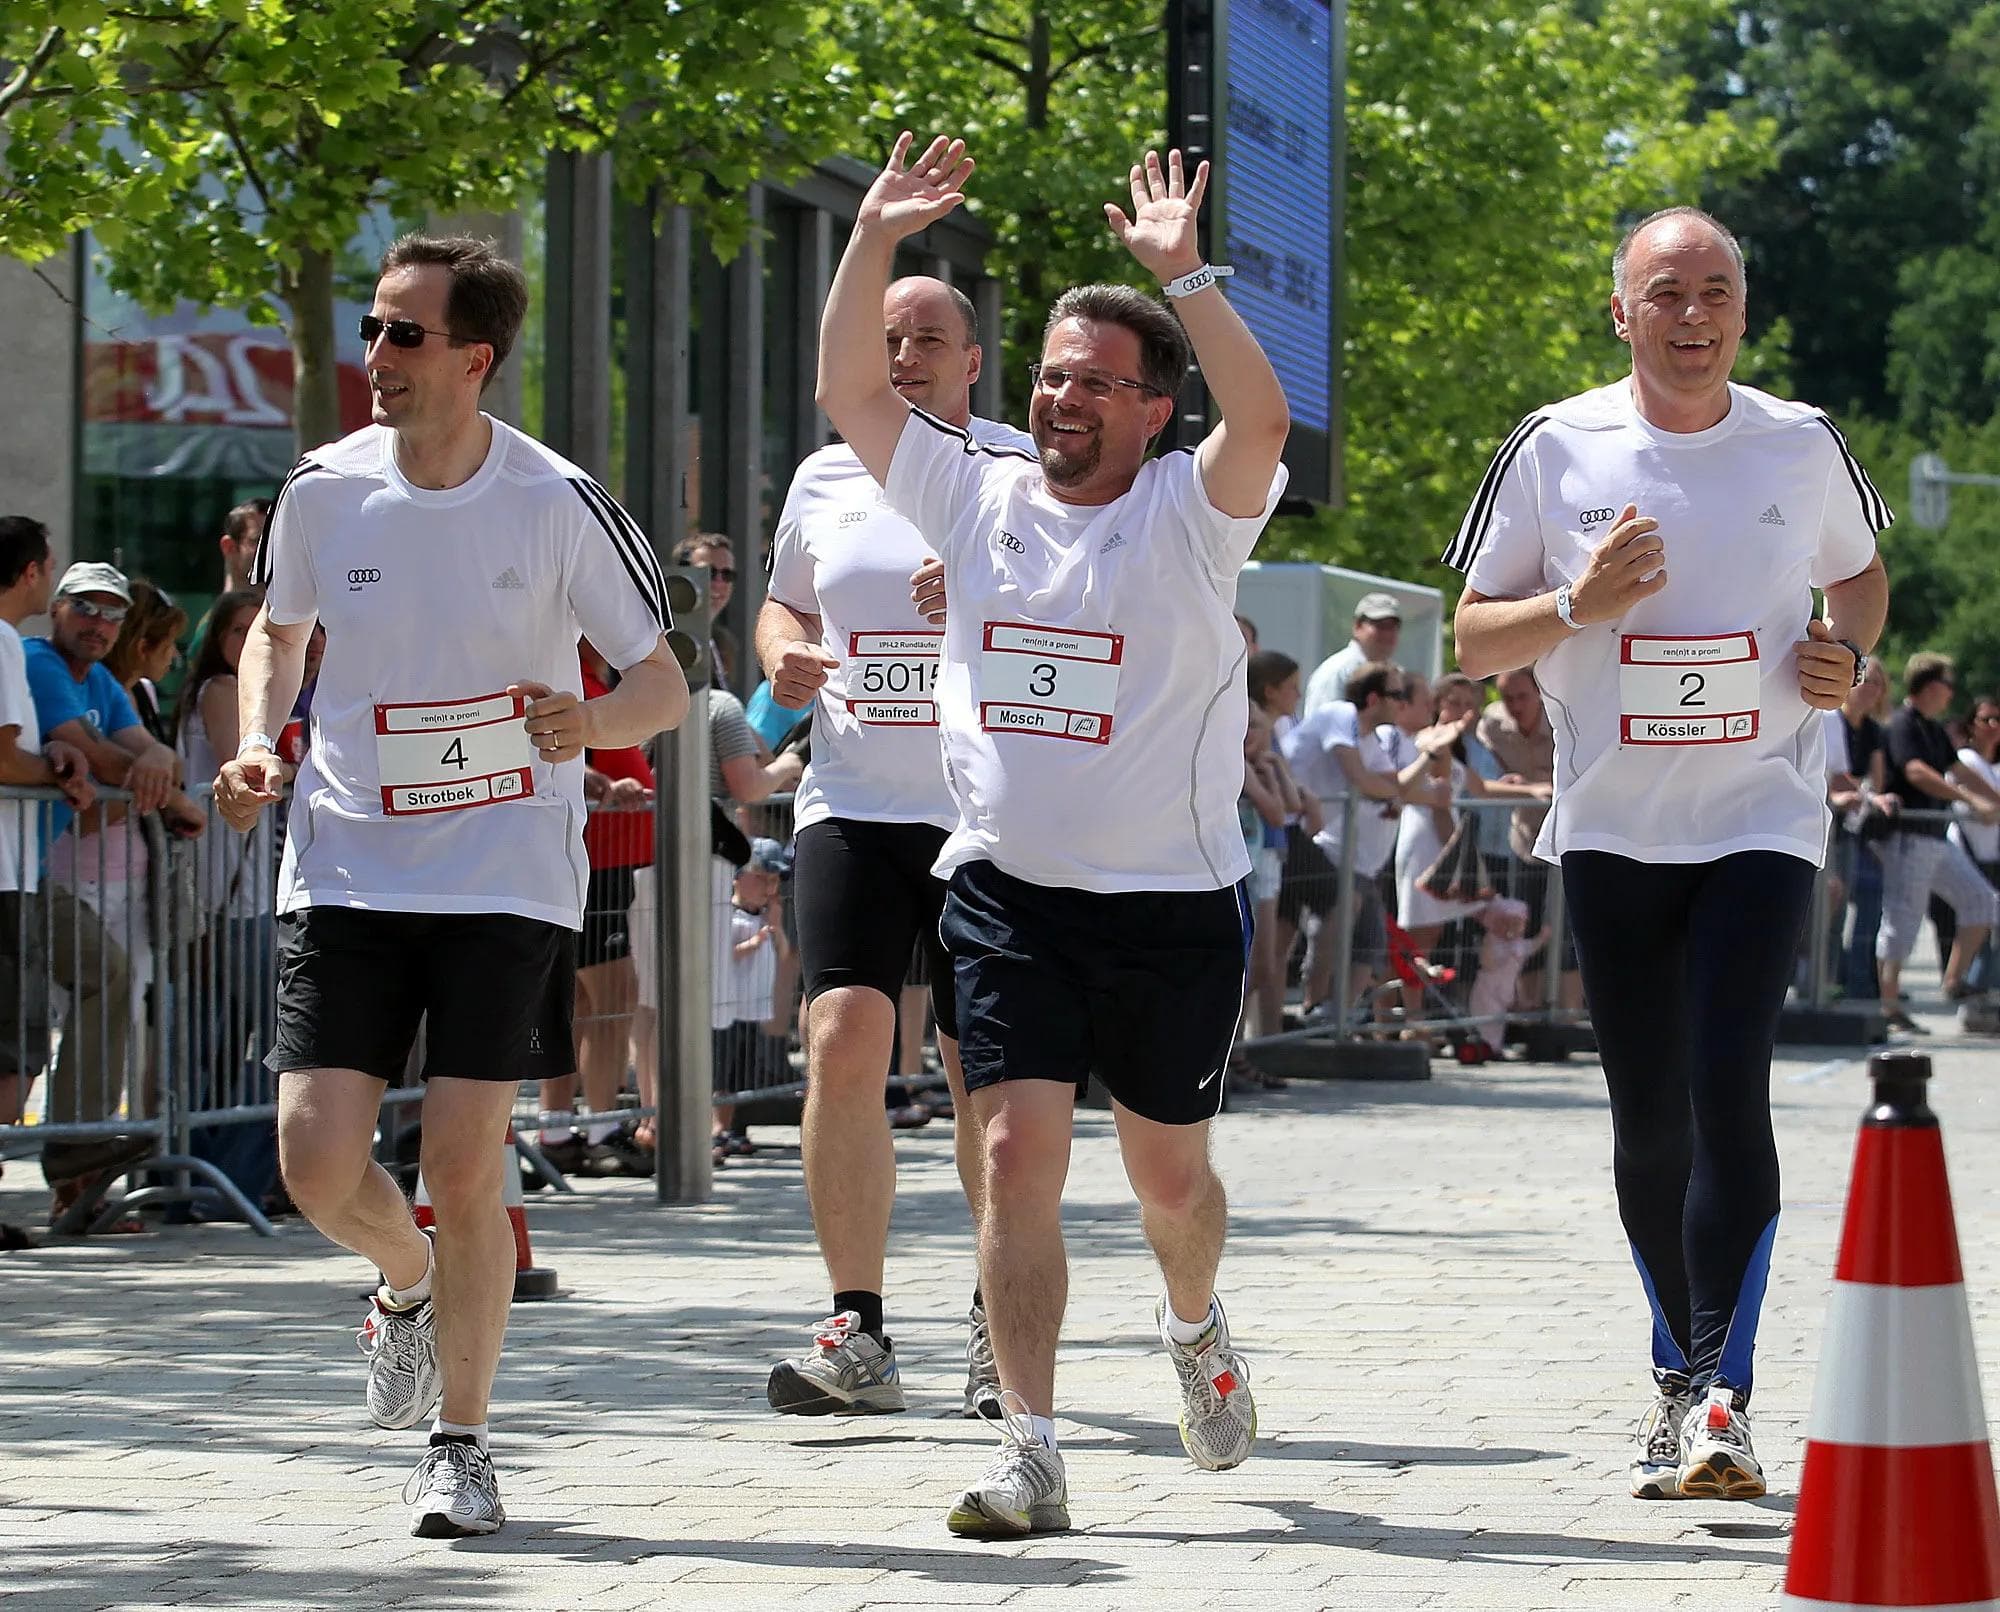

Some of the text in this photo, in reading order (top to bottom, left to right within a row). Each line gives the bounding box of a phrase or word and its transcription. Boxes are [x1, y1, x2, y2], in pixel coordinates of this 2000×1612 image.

[1021, 637, 1048, 648] ren(n)t
[1055, 641, 1079, 651] promi
[1663, 648, 1690, 657] ren(n)t
[1698, 647, 1721, 657] promi
[1029, 663, 1057, 697] 3
[1679, 672, 1706, 706] 2
[420, 713, 449, 724] ren(n)t
[456, 709, 480, 721] promi
[867, 706, 919, 718] Manfred
[999, 710, 1045, 726] Mosch
[1647, 723, 1707, 737] Kössler
[440, 737, 469, 770] 4
[407, 786, 475, 806] Strotbek
